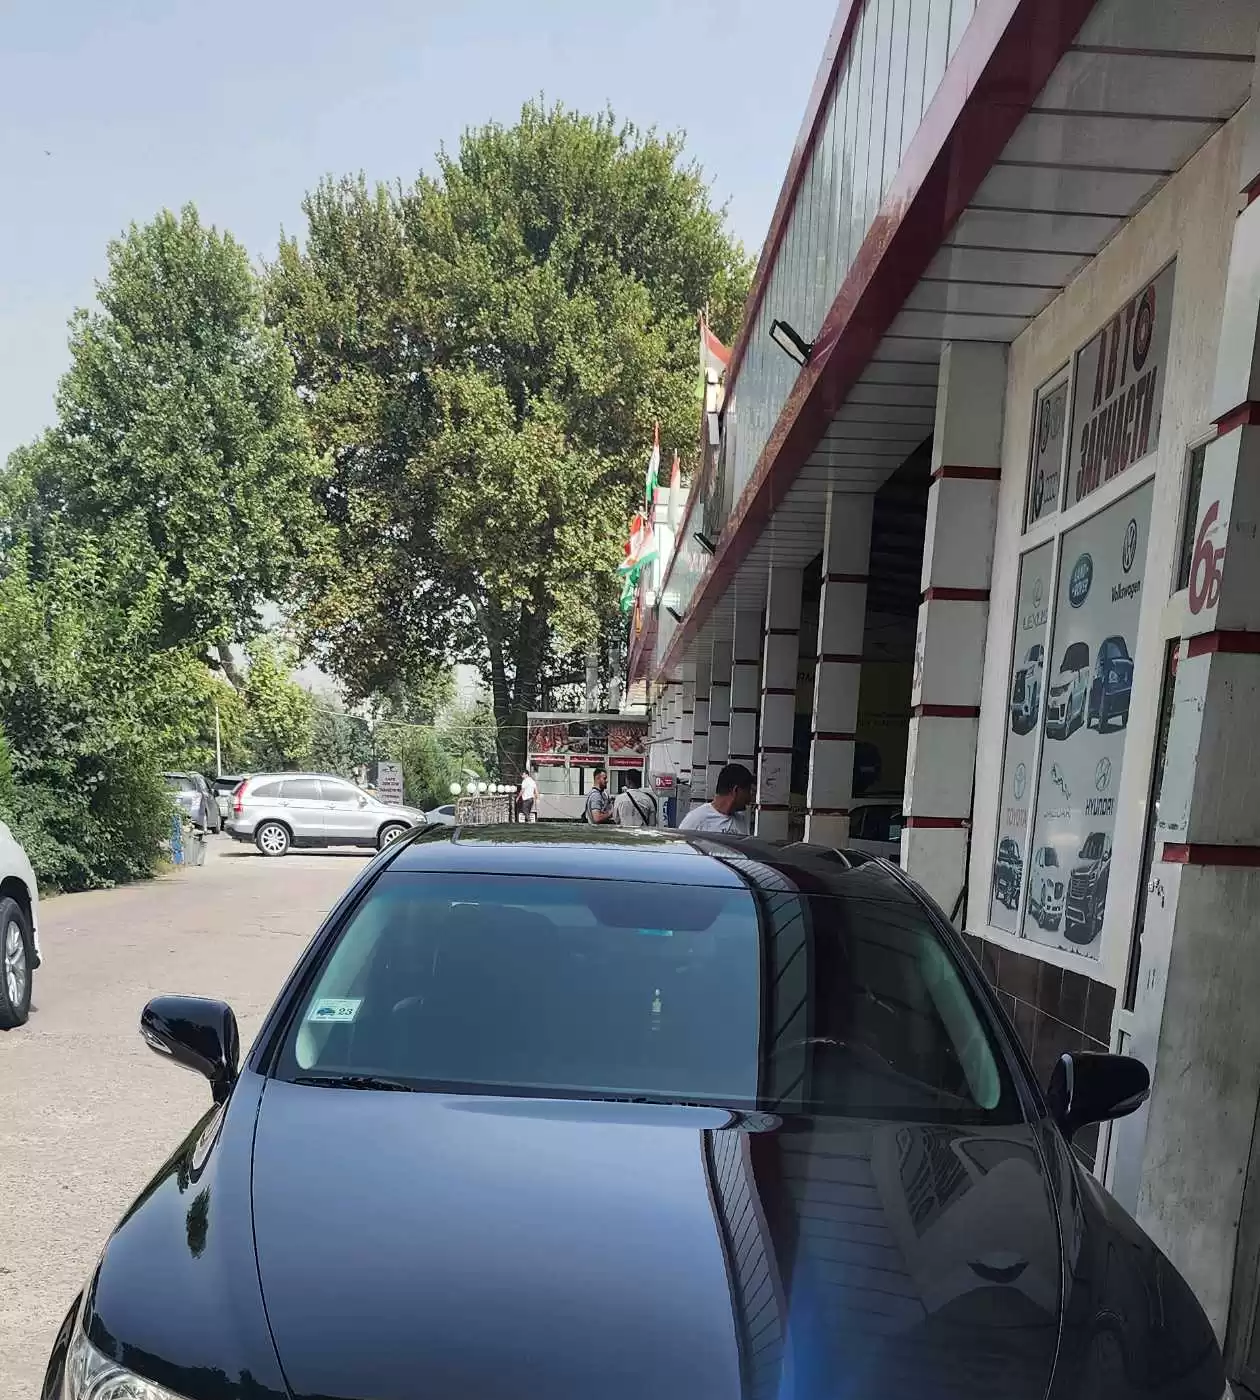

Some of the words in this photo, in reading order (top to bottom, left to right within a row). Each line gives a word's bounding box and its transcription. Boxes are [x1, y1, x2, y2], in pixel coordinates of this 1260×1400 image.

[1092, 285, 1156, 411] АВТО
[1076, 366, 1157, 503] ЗАПЧАСТИ
[1085, 798, 1115, 816] HYUNDAI
